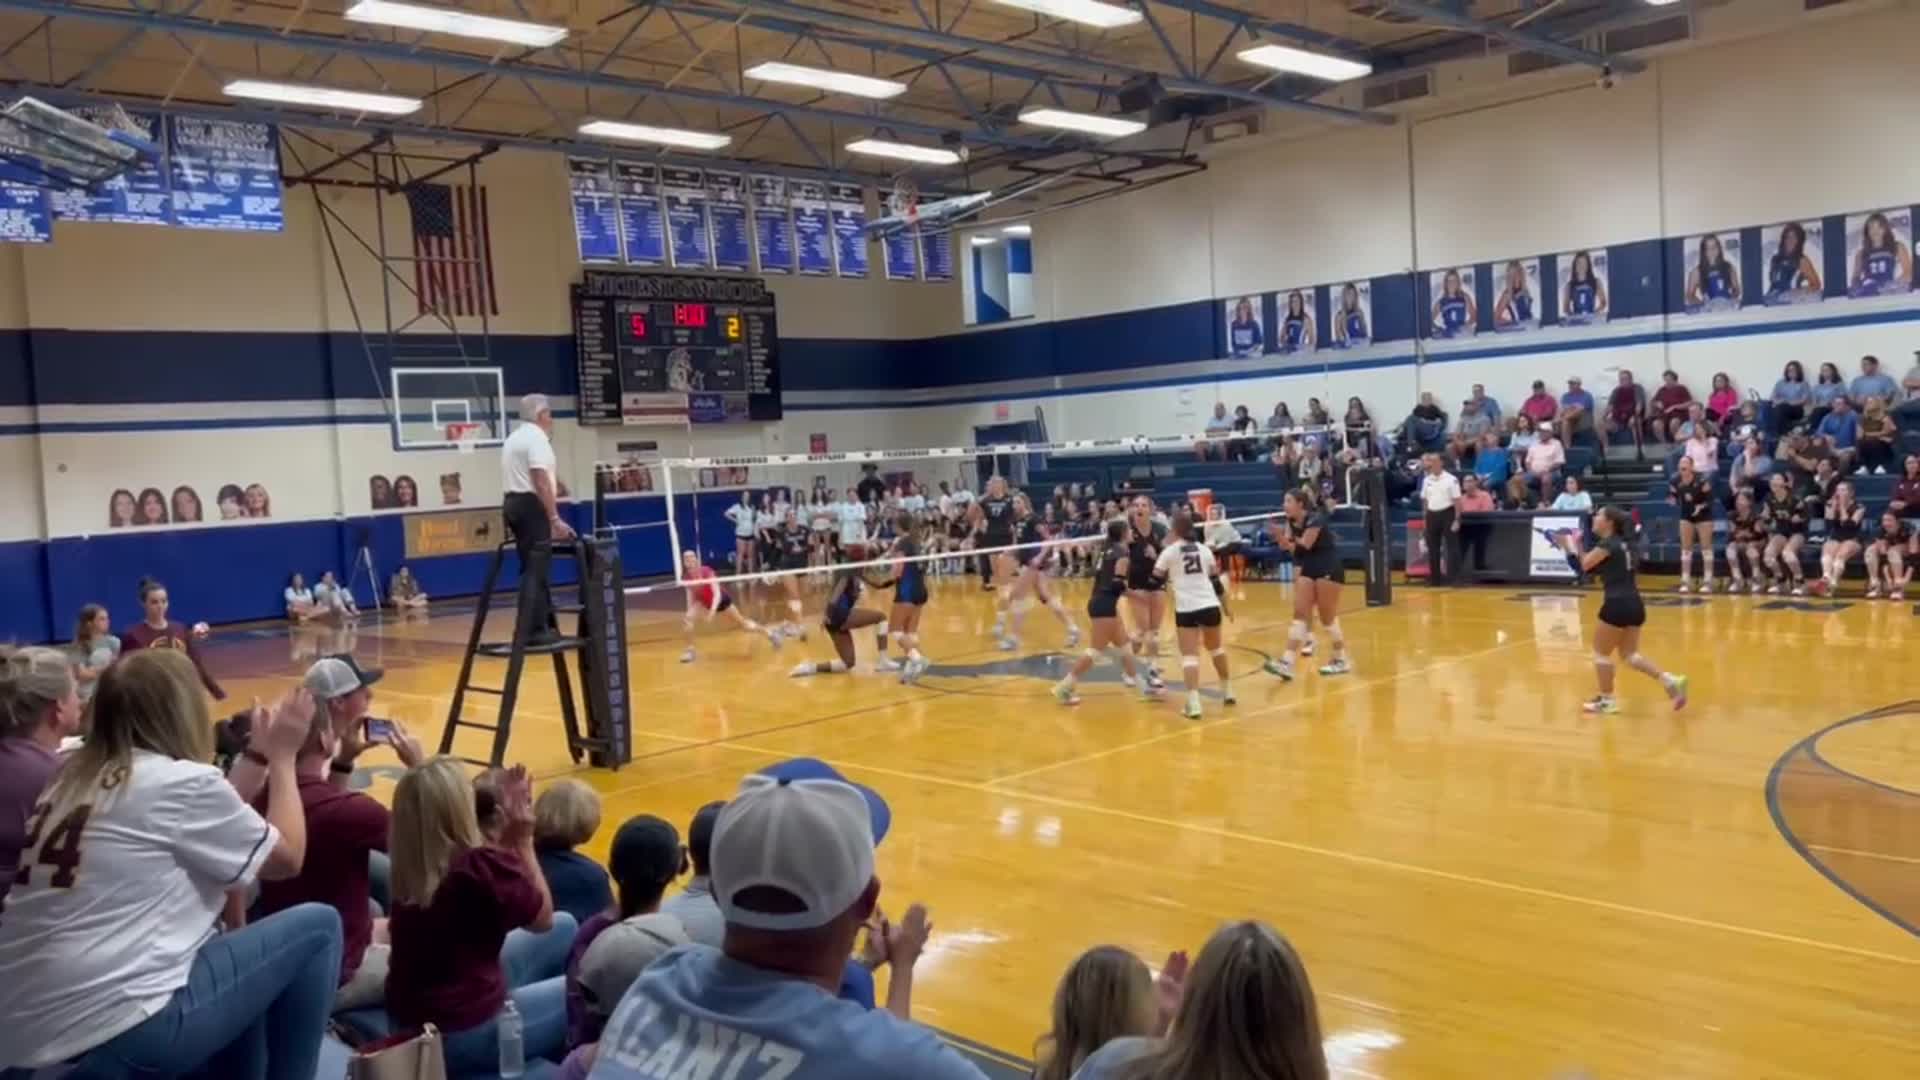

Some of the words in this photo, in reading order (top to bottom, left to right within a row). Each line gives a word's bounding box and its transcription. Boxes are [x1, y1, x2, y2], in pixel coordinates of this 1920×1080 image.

[631, 313, 645, 338] 5
[727, 316, 740, 338] 2
[1183, 553, 1204, 575] 21
